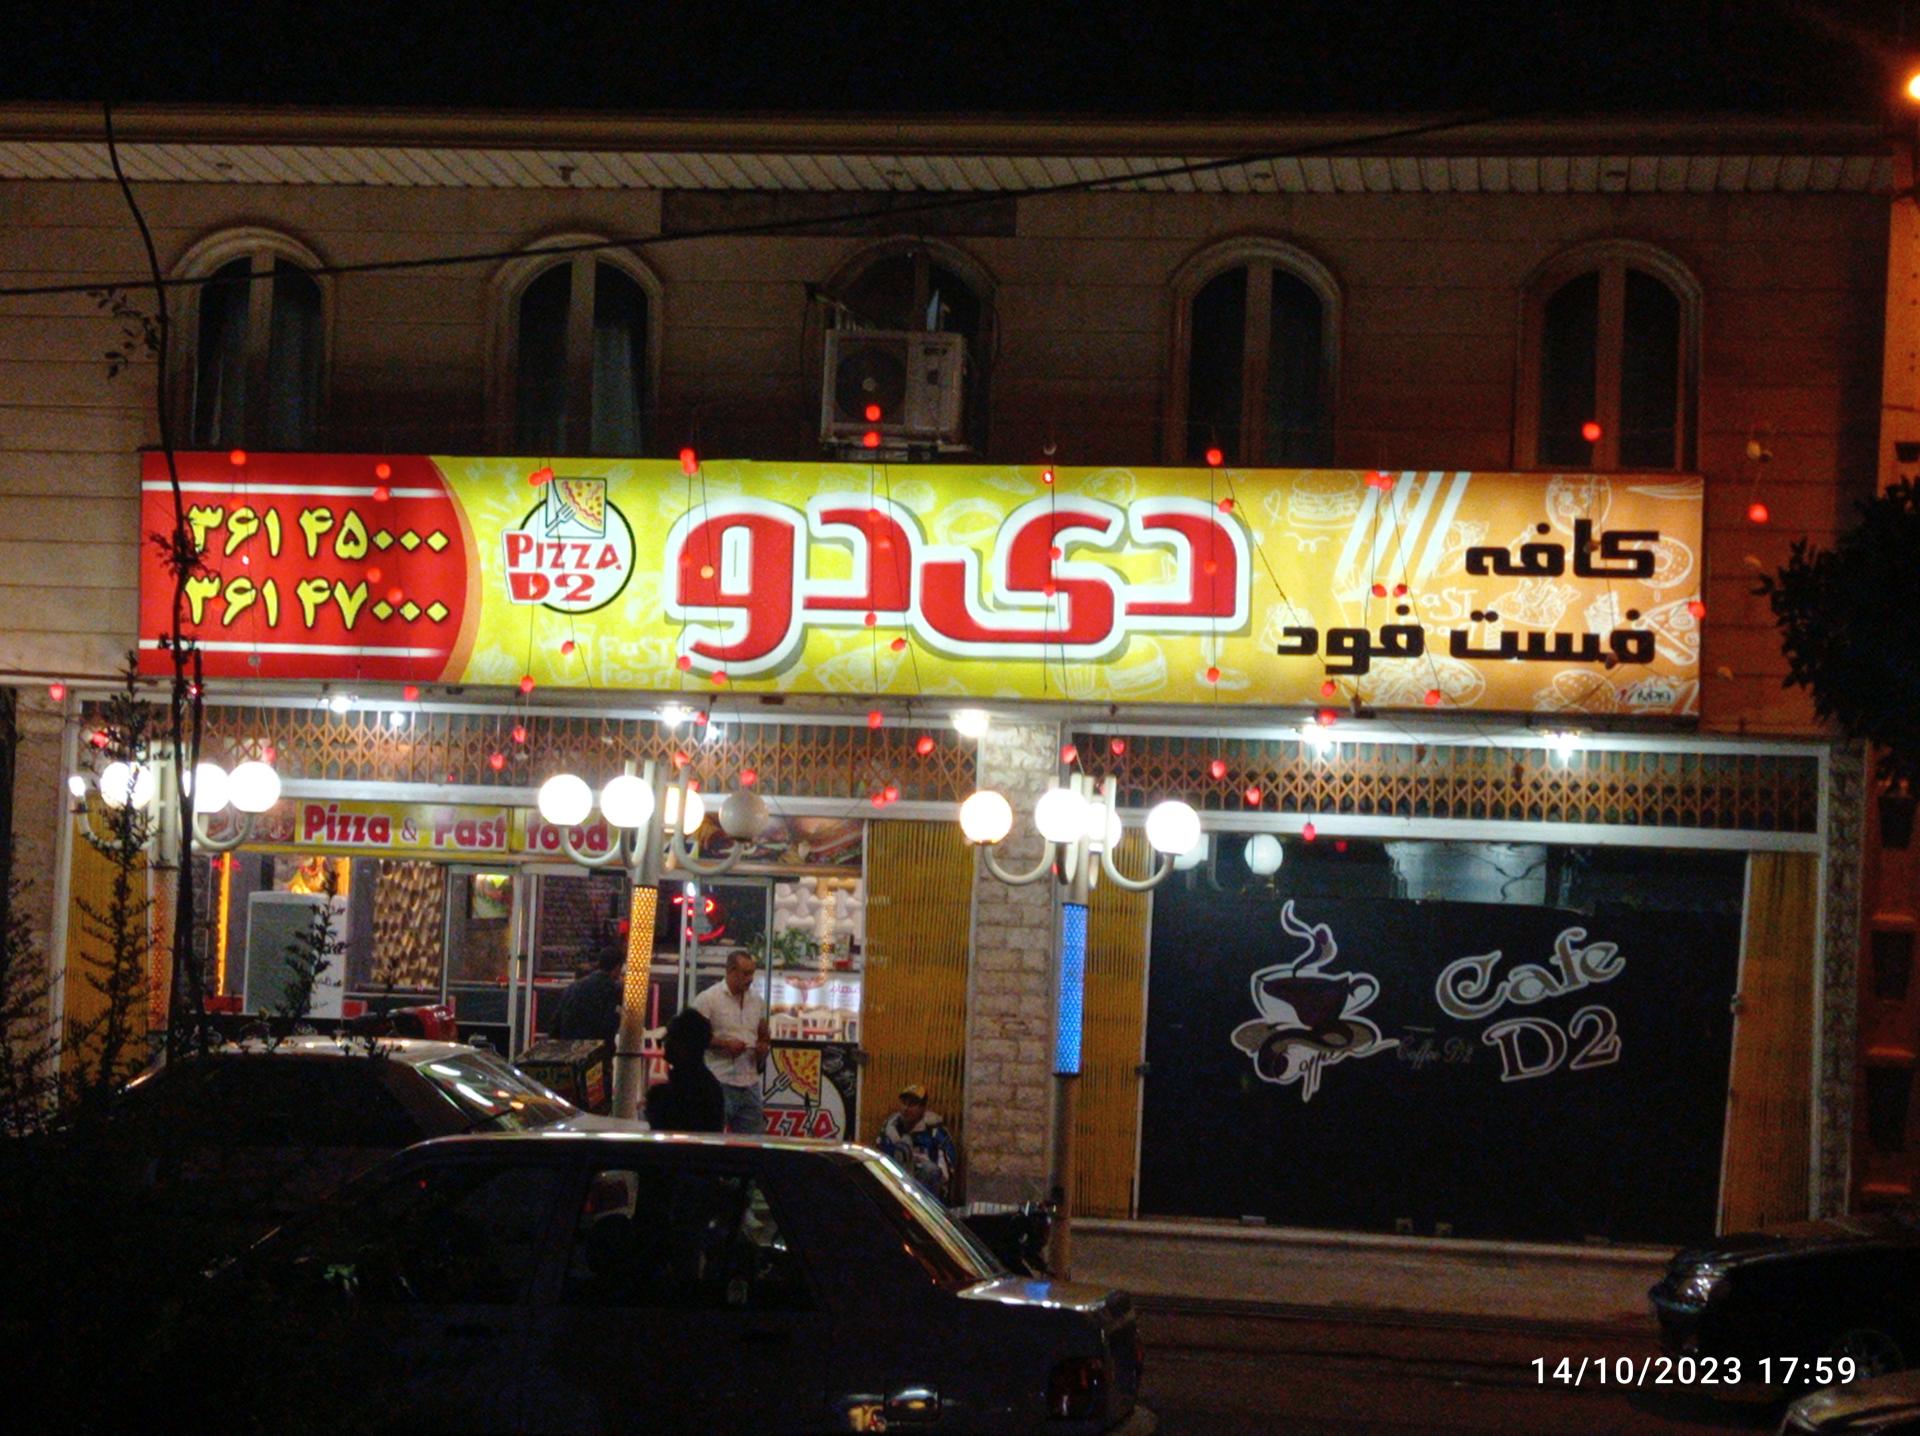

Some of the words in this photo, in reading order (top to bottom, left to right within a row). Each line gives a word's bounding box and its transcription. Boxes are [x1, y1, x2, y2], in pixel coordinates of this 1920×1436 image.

[187, 504, 282, 558] ۳۶۱
[298, 506, 449, 561] ۴۵۰۰۰
[506, 533, 622, 570] PIZZA
[1465, 518, 1660, 579] کافه
[184, 574, 279, 629] ۳۶۱
[296, 577, 449, 631] ۴۷۰۰۰
[508, 572, 595, 602] D2
[674, 506, 916, 664] دو
[1276, 603, 1425, 676] فود
[1448, 608, 1656, 665] فست
[303, 803, 391, 844] Pizza
[402, 817, 418, 842] &
[1436, 927, 1627, 1020] Cafe
[1482, 1005, 1622, 1083] D2
[762, 1109, 840, 1138] ZZA
